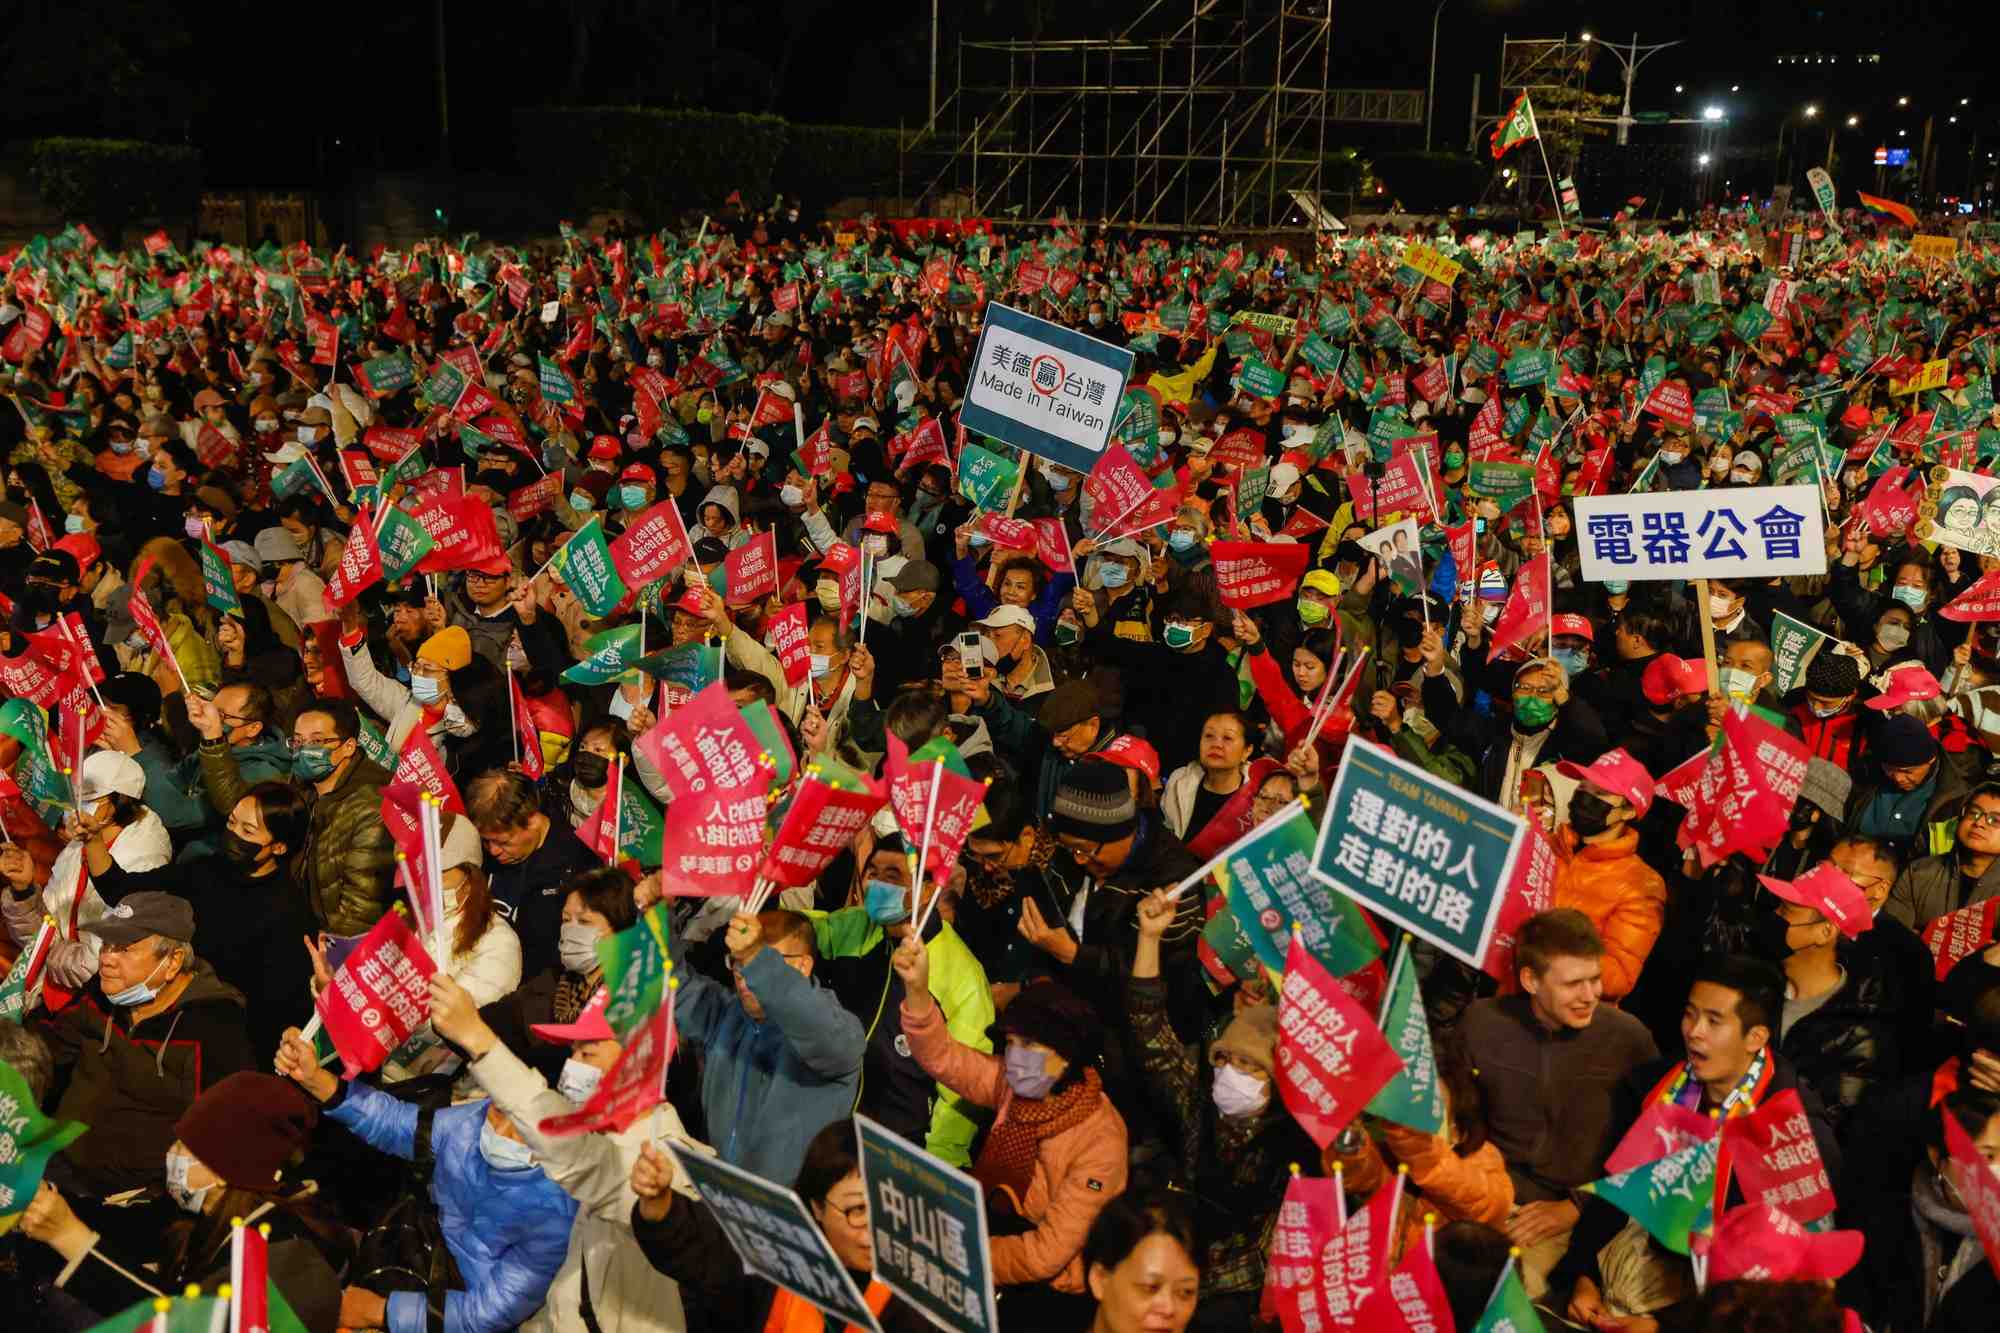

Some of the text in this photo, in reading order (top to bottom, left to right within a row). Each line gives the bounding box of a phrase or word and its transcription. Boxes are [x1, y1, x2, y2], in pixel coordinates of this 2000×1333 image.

[980, 371, 1104, 431] Made in Taiwan
[990, 344, 1106, 407] 美德贏台灣
[1587, 504, 1807, 566] 電器公會
[1347, 787, 1480, 889] 選對的人
[1334, 832, 1473, 935] 走對的路
[1282, 969, 1359, 1056] 選對的人
